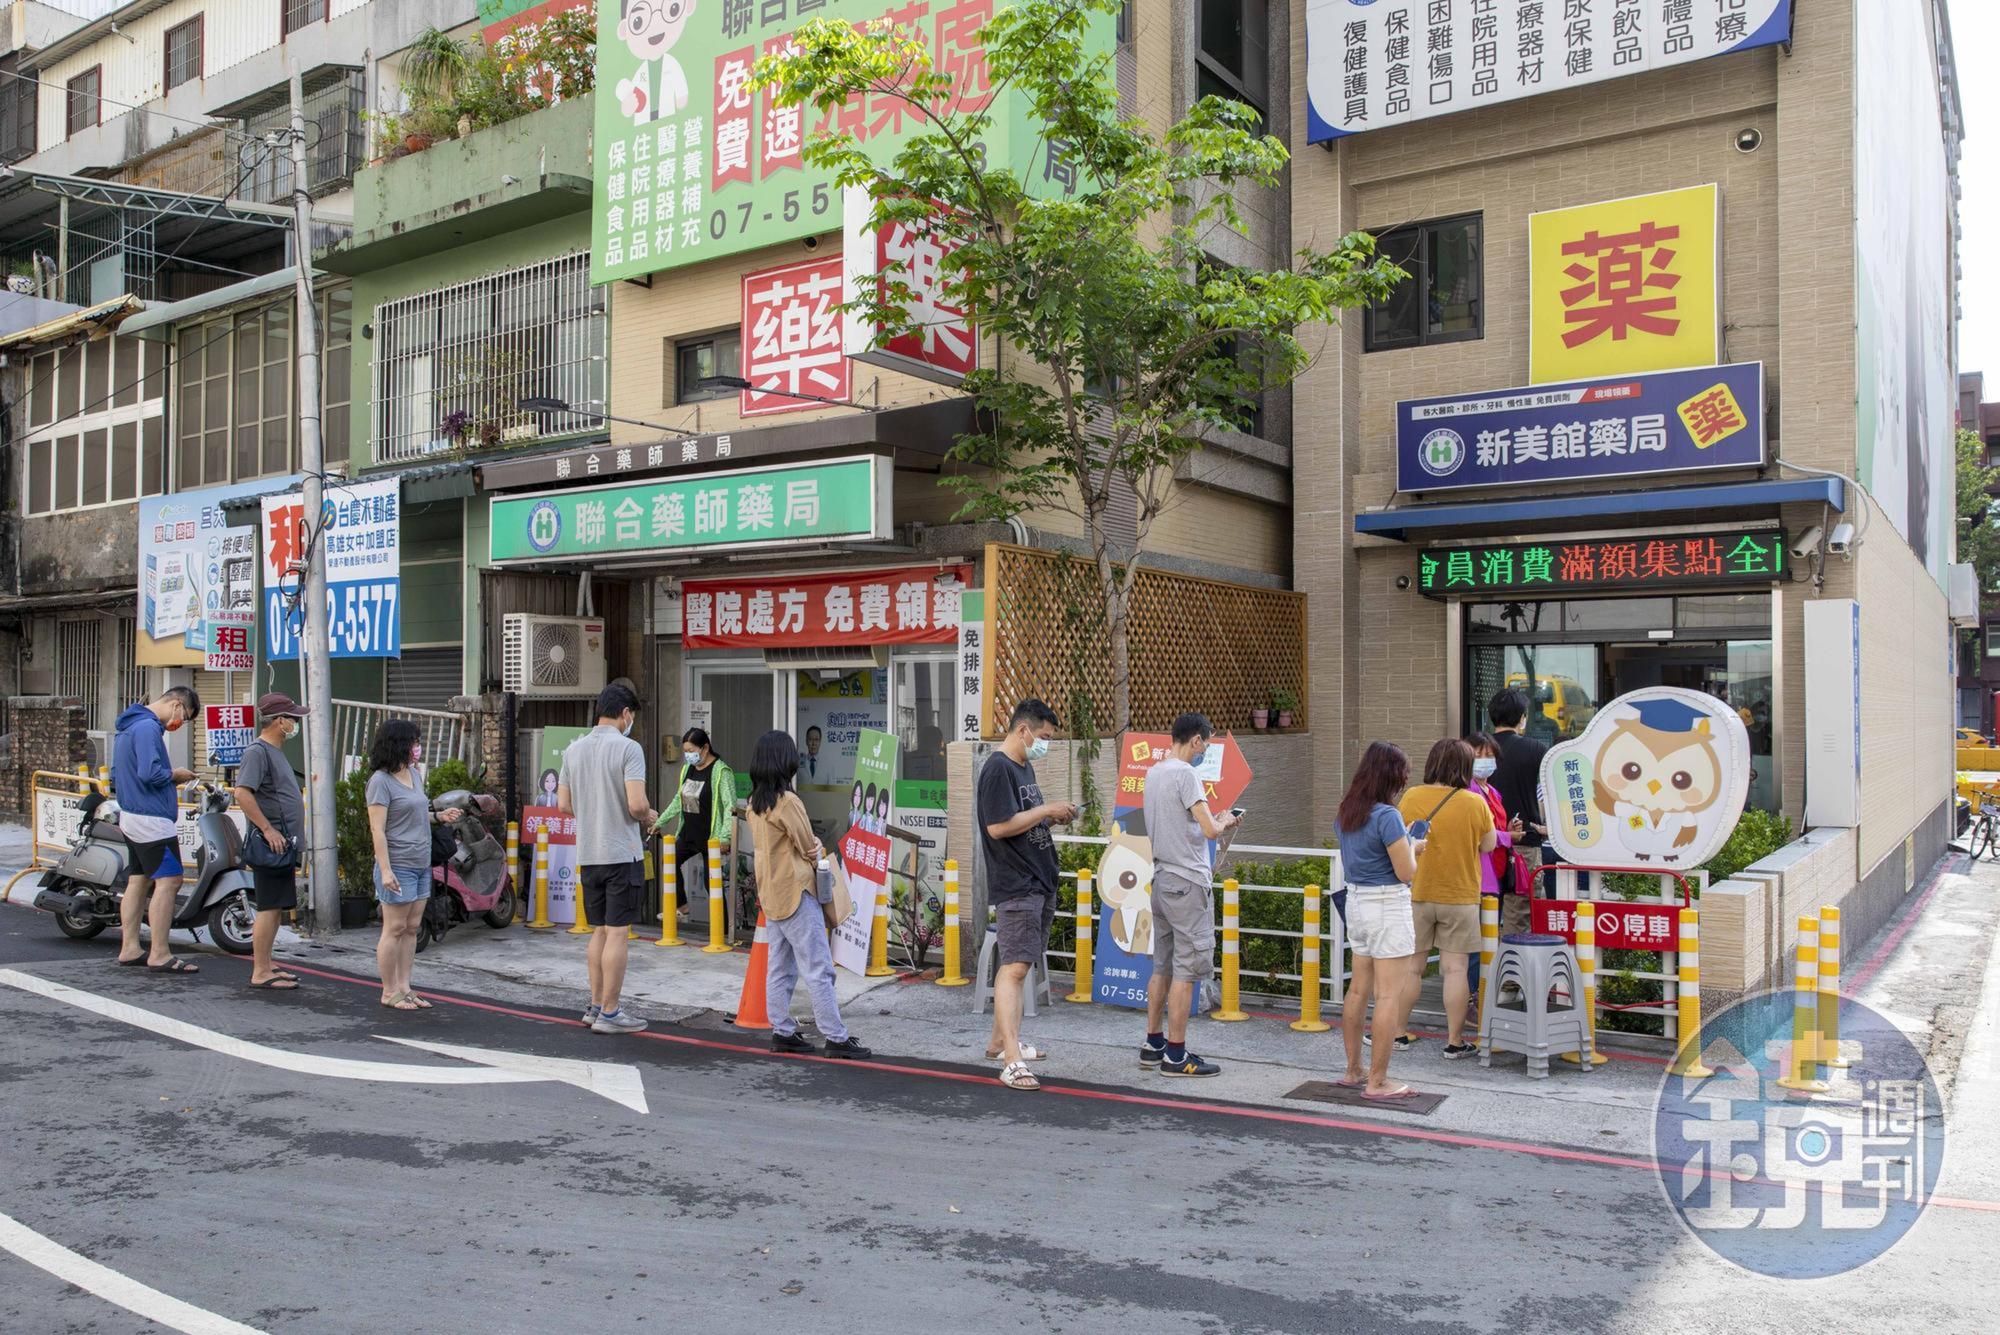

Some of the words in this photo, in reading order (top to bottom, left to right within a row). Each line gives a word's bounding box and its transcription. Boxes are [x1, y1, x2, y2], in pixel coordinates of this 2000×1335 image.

[1427, 0, 1453, 105] 困難傷口
[1516, 0, 1545, 86] 療器材
[1612, 0, 1642, 66] 飲品
[1662, 0, 1694, 55] 禮品
[1343, 20, 1368, 126] 復健護具
[1384, 8, 1410, 116] 保健食品
[717, 59, 751, 177] 免費
[605, 140, 627, 268] 保健食品
[630, 132, 651, 262] 住院用品
[655, 123, 677, 255] 醫療器材
[681, 115, 703, 249] 營養補充
[884, 215, 973, 363] 藥
[751, 272, 842, 401] 藥
[556, 434, 732, 478] 聯合藥師藥局
[1475, 413, 1667, 467] 新美館藥局
[326, 527, 396, 553] 高雄女中加盟店
[339, 493, 397, 527] 台慶不動產
[574, 479, 821, 546] 聯合藥師藥局
[215, 626, 248, 652] 租
[685, 588, 807, 637] 醫院處方
[824, 582, 966, 633] 免費領藥
[964, 629, 980, 695] 免排隊
[218, 707, 245, 728] 租
[964, 714, 980, 740] 免
[900, 815, 925, 827] NISSEI
[1563, 759, 1589, 826] 新美館藥局
[1547, 909, 1577, 932] 請
[1623, 913, 1671, 937] 停車
